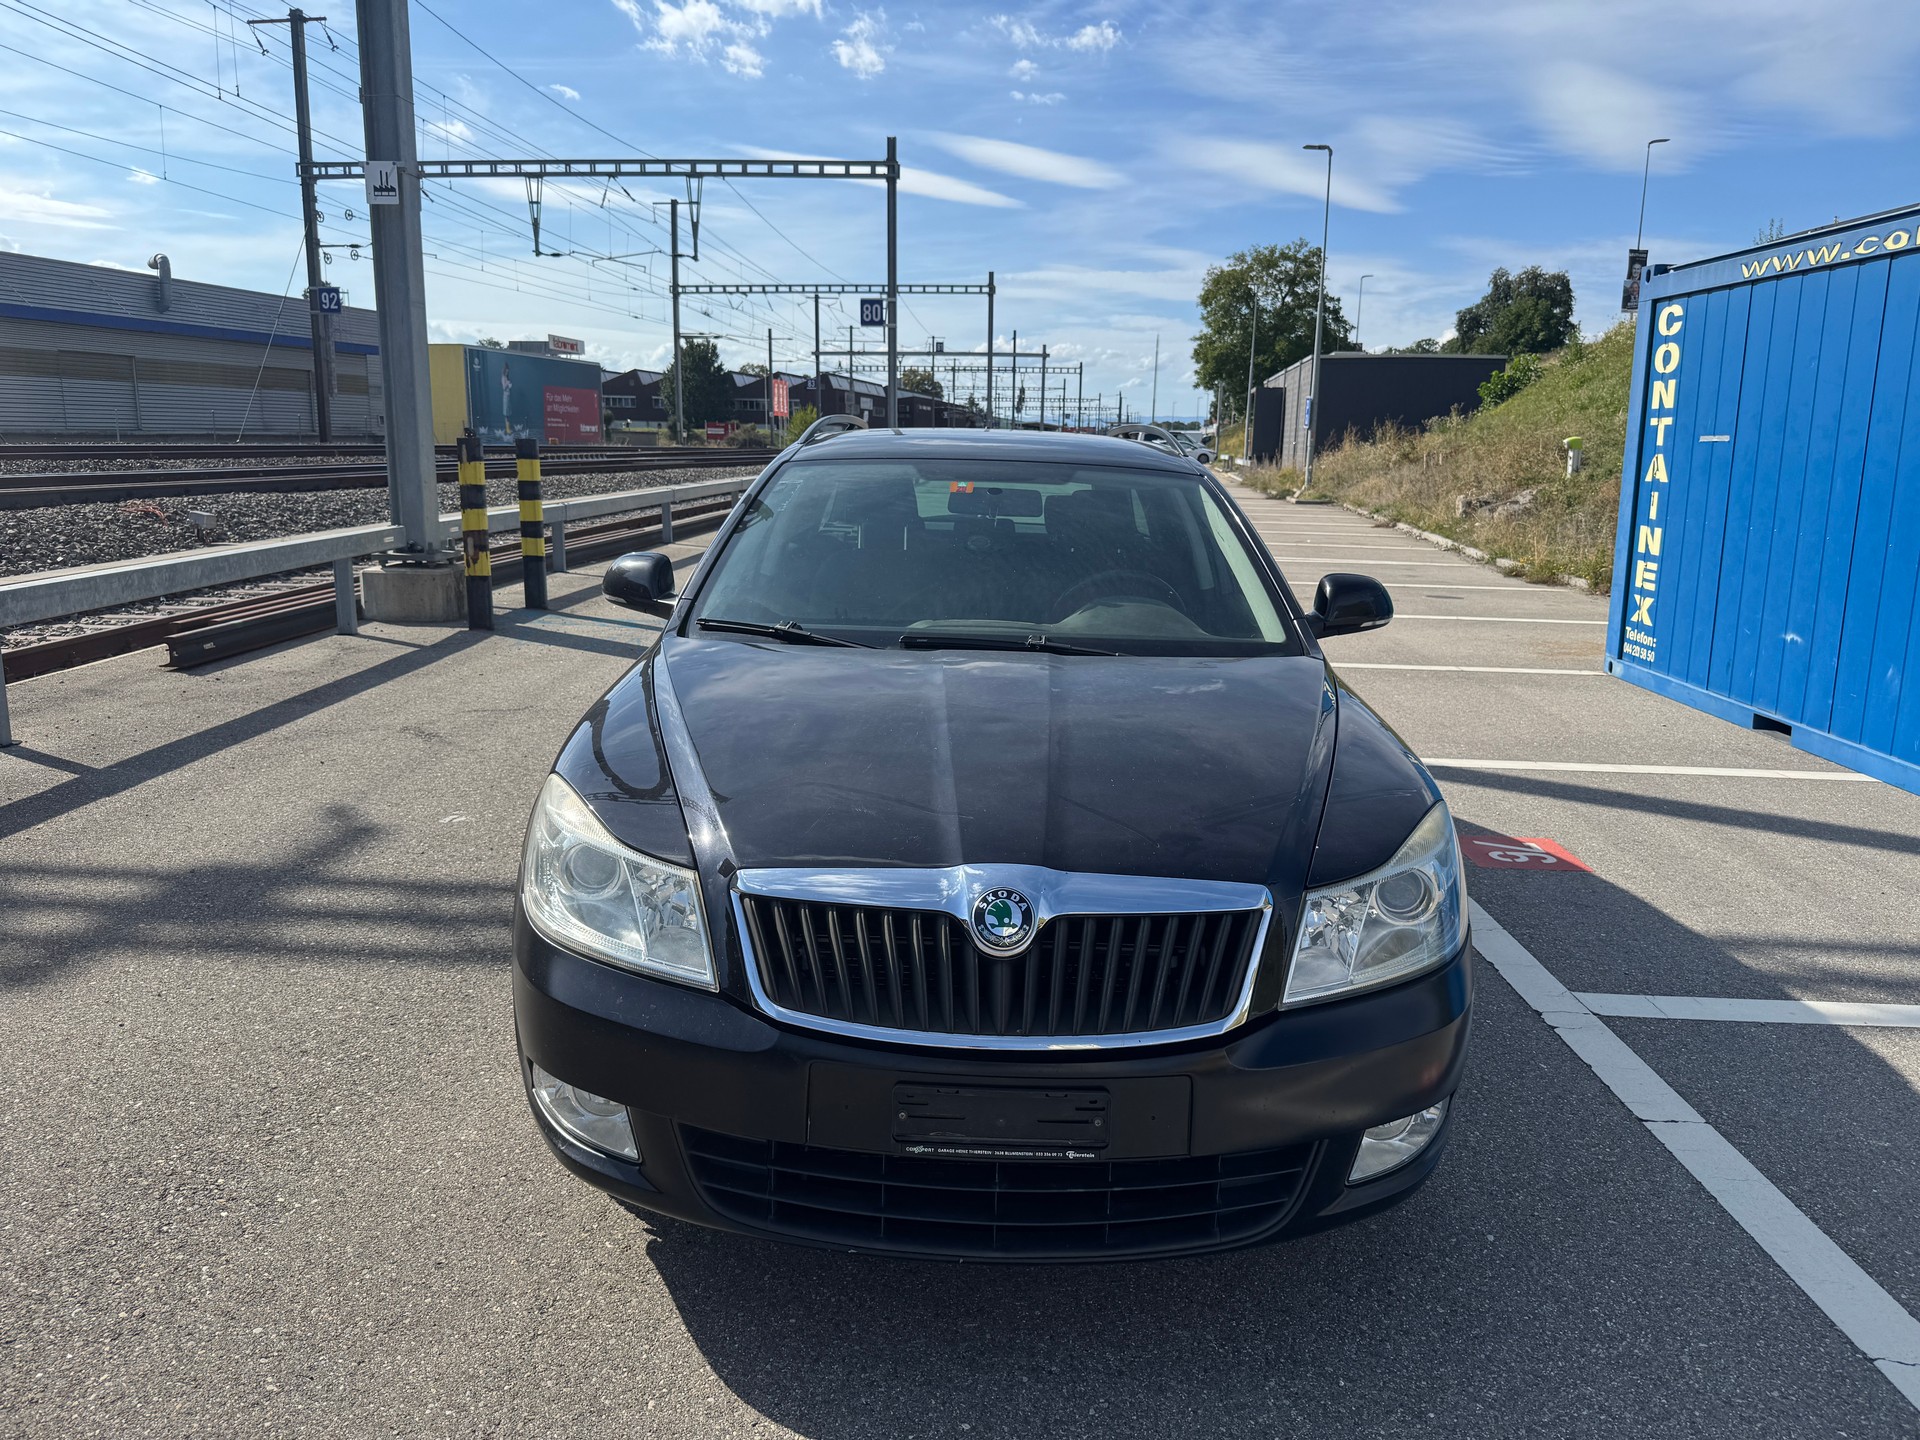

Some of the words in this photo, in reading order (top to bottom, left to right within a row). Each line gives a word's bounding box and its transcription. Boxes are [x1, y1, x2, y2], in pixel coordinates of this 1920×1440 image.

[321, 292, 339, 309] 92
[863, 304, 881, 322] 80
[807, 380, 816, 388] 83
[1630, 304, 1684, 626] CONTAINEX
[1625, 626, 1657, 648] Telefon:
[1647, 650, 1655, 662] 50
